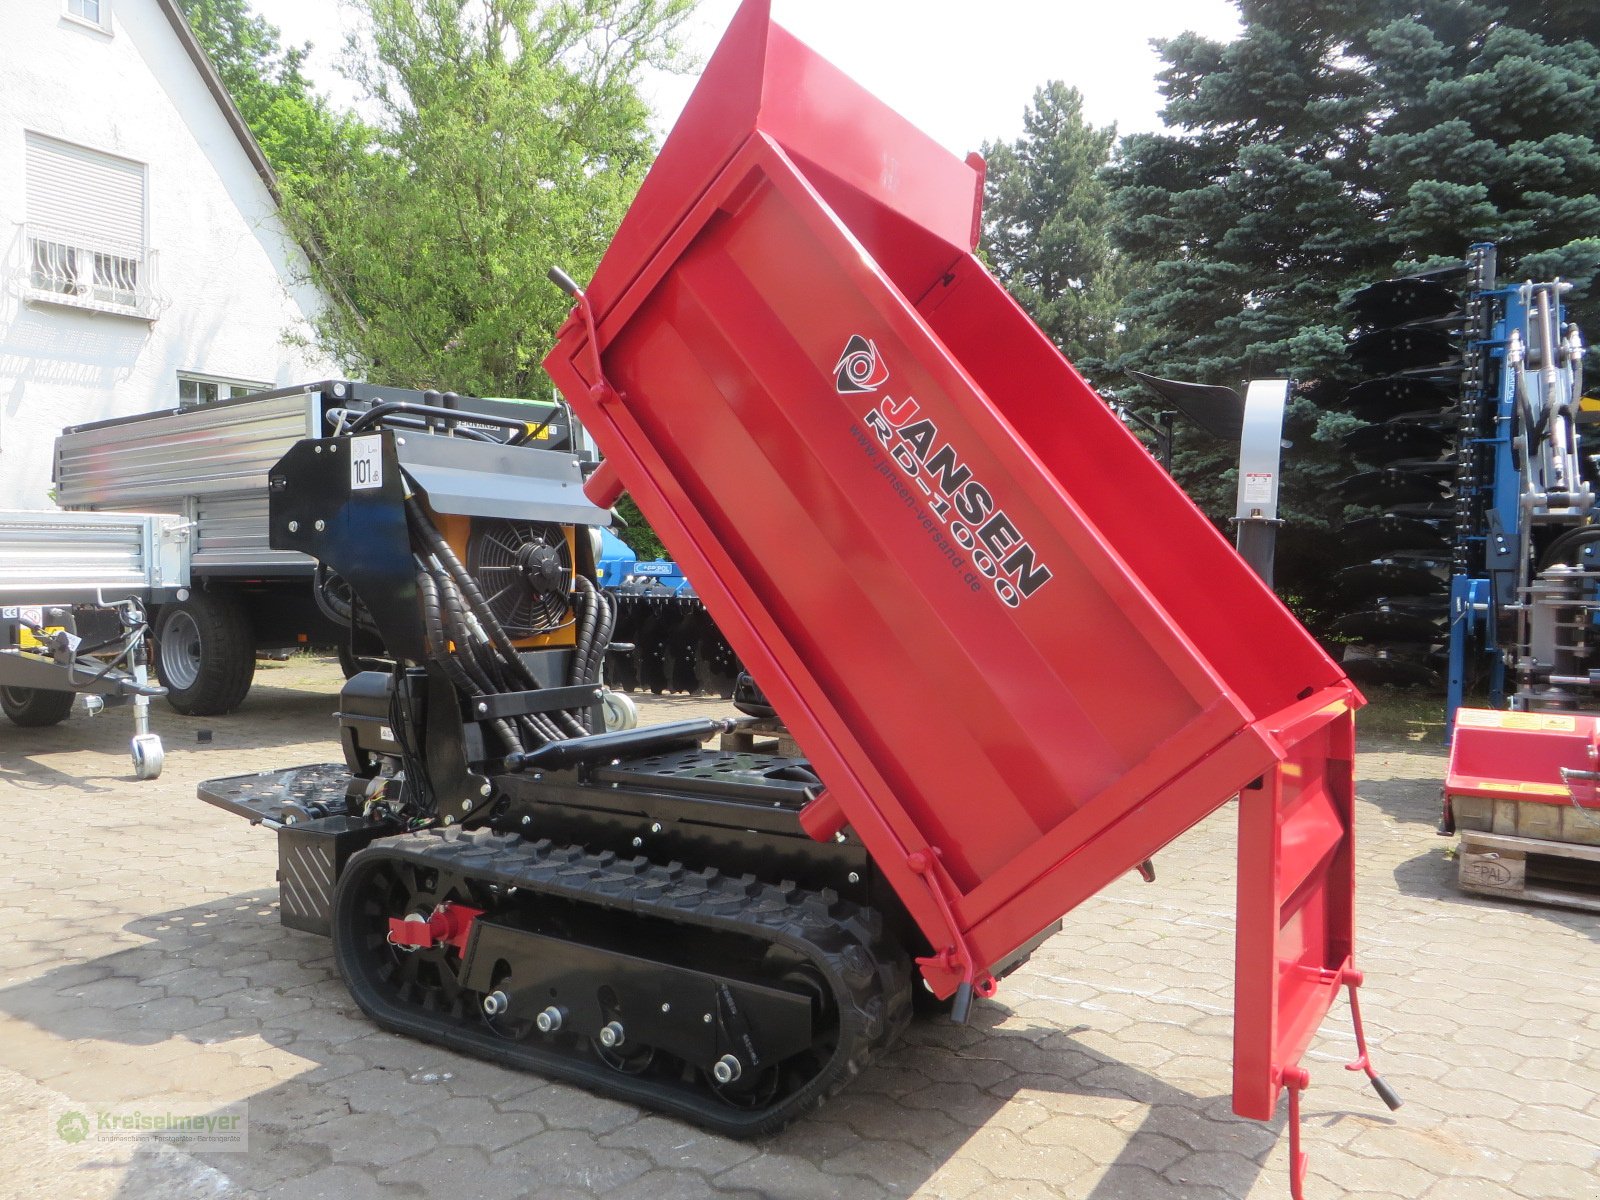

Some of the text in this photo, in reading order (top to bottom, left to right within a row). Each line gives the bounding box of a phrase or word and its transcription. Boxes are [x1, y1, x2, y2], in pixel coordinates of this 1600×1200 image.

[353, 459, 371, 484] 101
[850, 423, 982, 593] www.jansen-versand.de
[864, 408, 1020, 608] RD-1000
[880, 395, 1053, 600] JANSEN
[1474, 865, 1505, 882] EPAL
